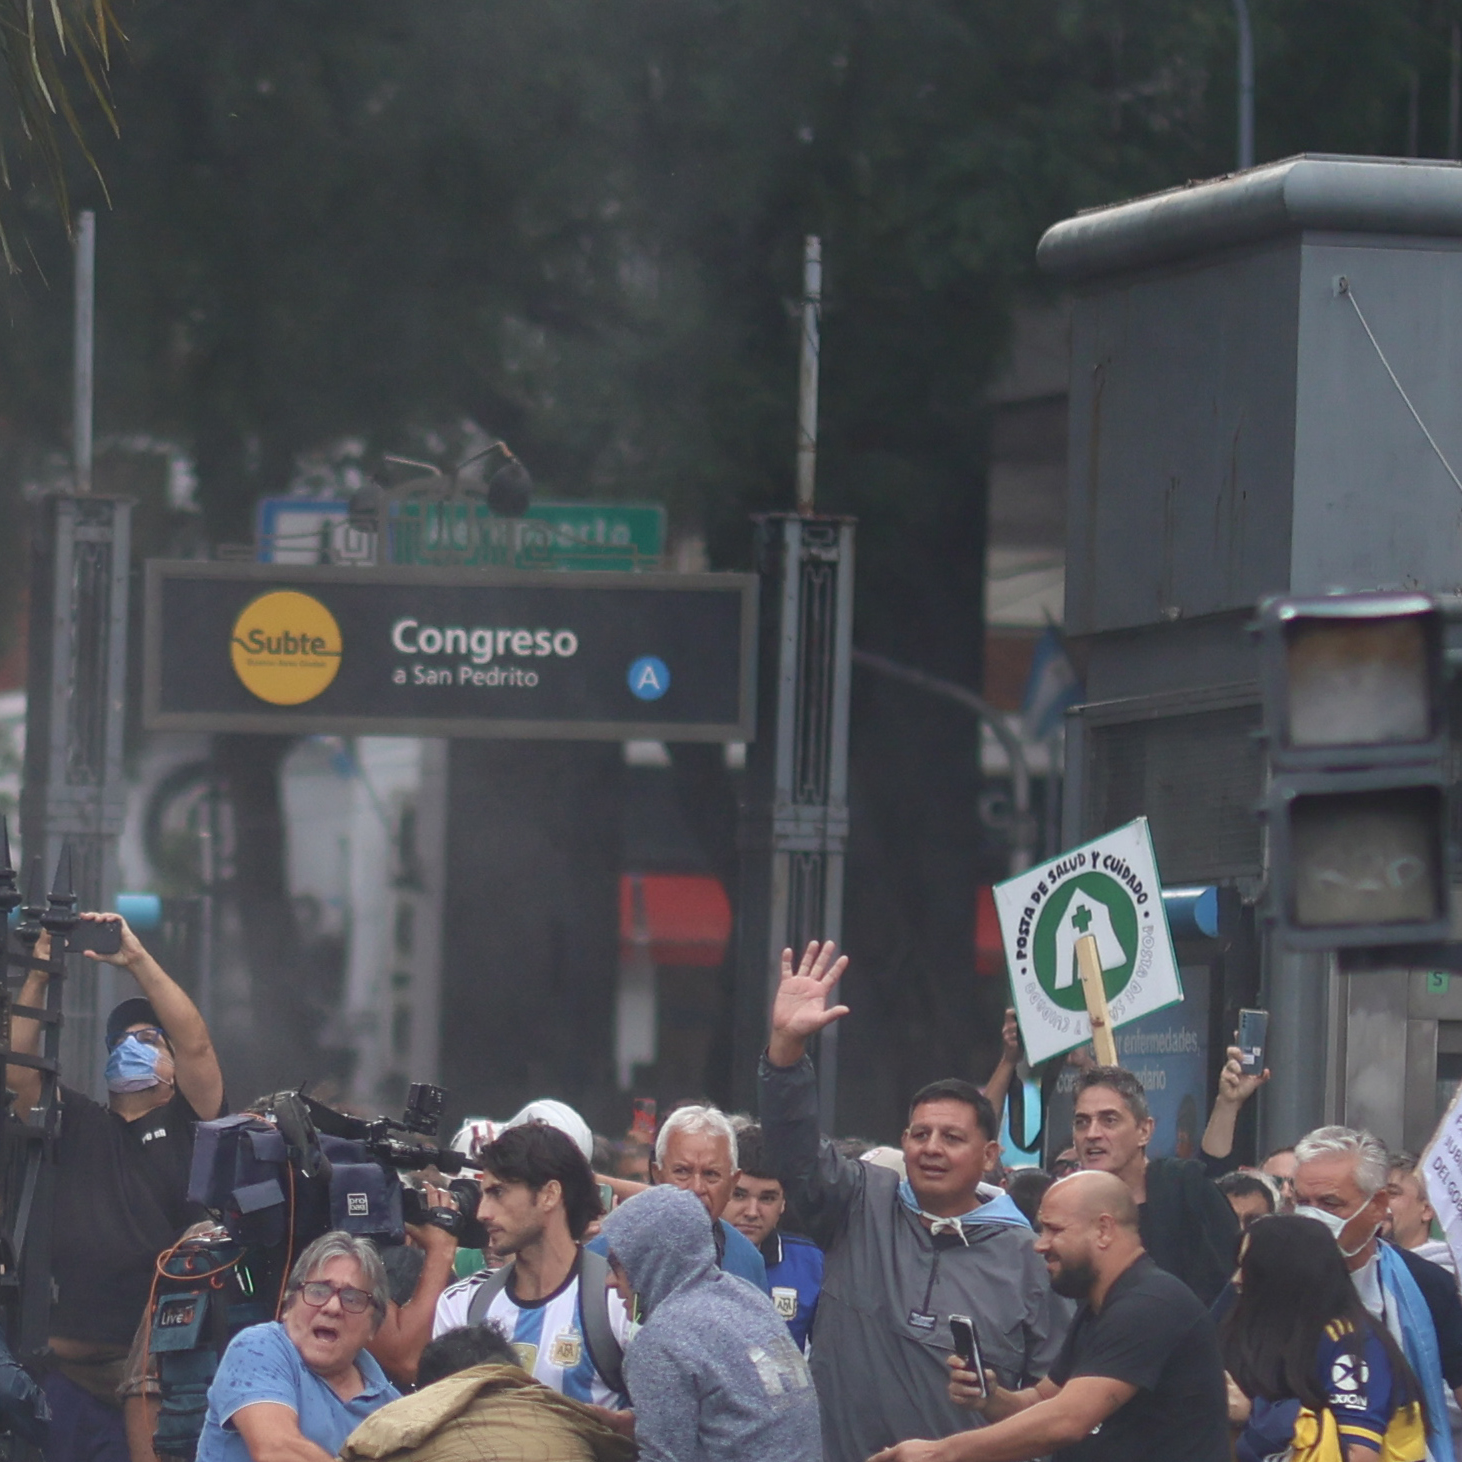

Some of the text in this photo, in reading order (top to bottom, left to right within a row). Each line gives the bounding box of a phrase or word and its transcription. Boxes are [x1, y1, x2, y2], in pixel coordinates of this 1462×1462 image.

[244, 628, 330, 656] Subte
[392, 619, 578, 664] Congreso
[393, 665, 539, 687] a San Pedrito
[637, 665, 660, 690] A
[1016, 851, 1148, 960] POSTA DE SALUD Y CUIDADO
